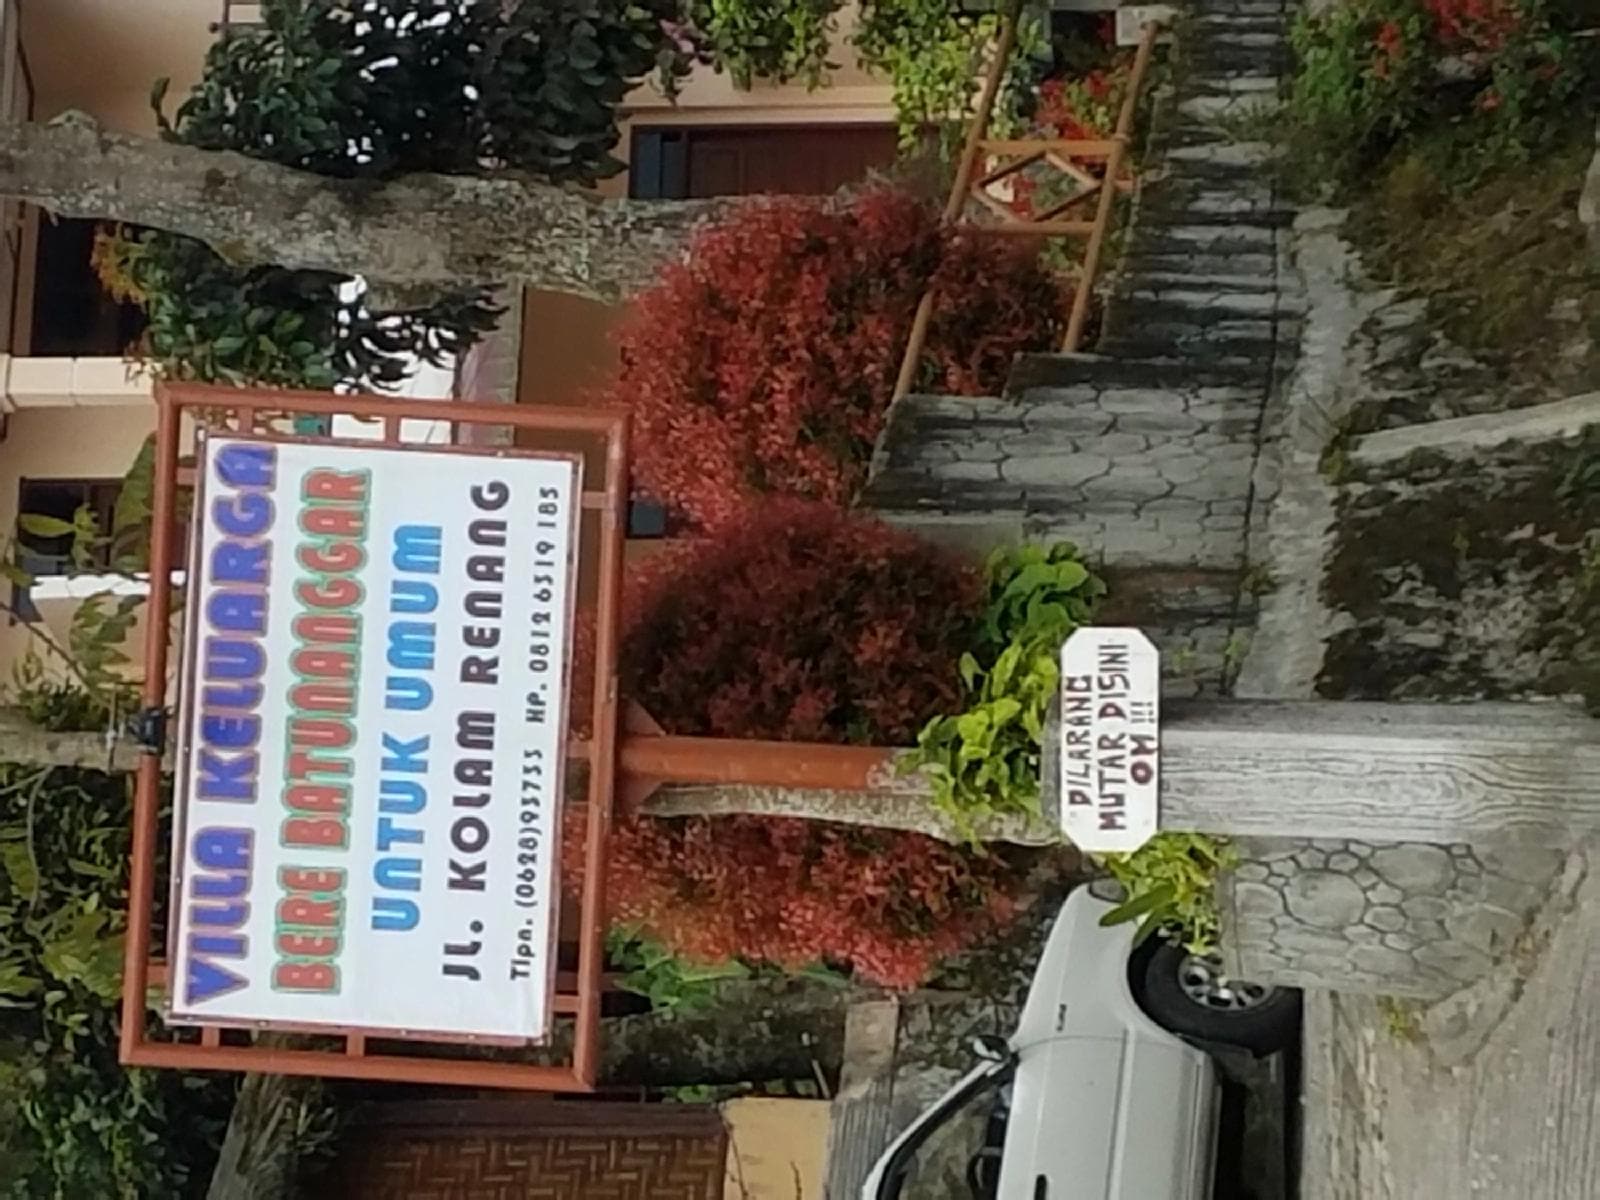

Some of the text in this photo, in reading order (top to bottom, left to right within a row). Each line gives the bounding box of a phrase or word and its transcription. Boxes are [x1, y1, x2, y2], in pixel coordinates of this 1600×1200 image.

[185, 443, 277, 1006] VILLA KELUARGA
[272, 467, 370, 994] BERE BATUNANGGAR
[372, 524, 442, 931] UNTUK UMUM
[443, 480, 509, 982] JL. KOLAM RENANG
[524, 684, 547, 724] HP.
[537, 487, 559, 530] 185
[1066, 675, 1092, 806] DILARANG
[1098, 644, 1130, 830] MUTAR DISINI
[1130, 735, 1155, 785] OM
